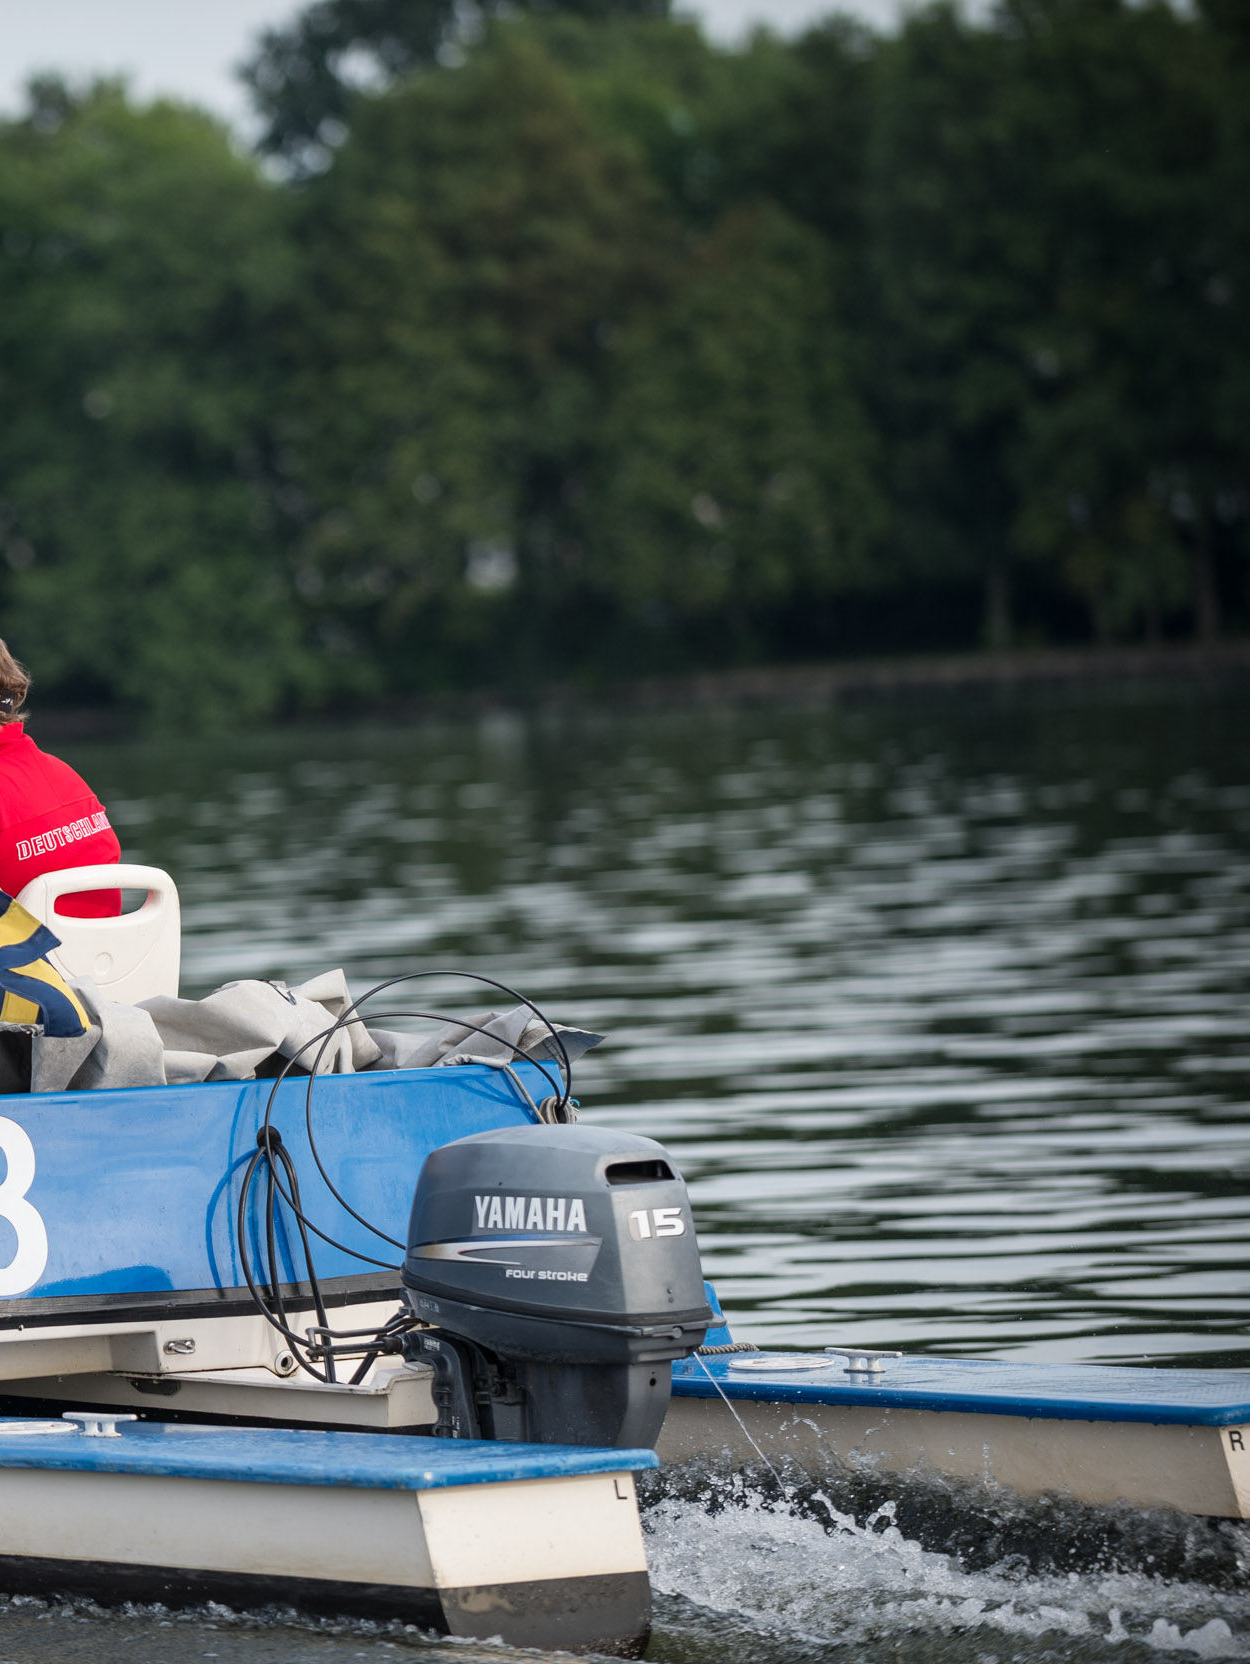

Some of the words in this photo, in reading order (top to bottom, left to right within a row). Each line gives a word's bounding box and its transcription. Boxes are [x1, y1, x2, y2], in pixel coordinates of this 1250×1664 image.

[15, 811, 112, 861] DEUTSCHLAN
[474, 1195, 588, 1232] YAMAHA
[629, 1207, 686, 1240] 15
[1228, 1430, 1246, 1451] R
[613, 1479, 628, 1500] L
